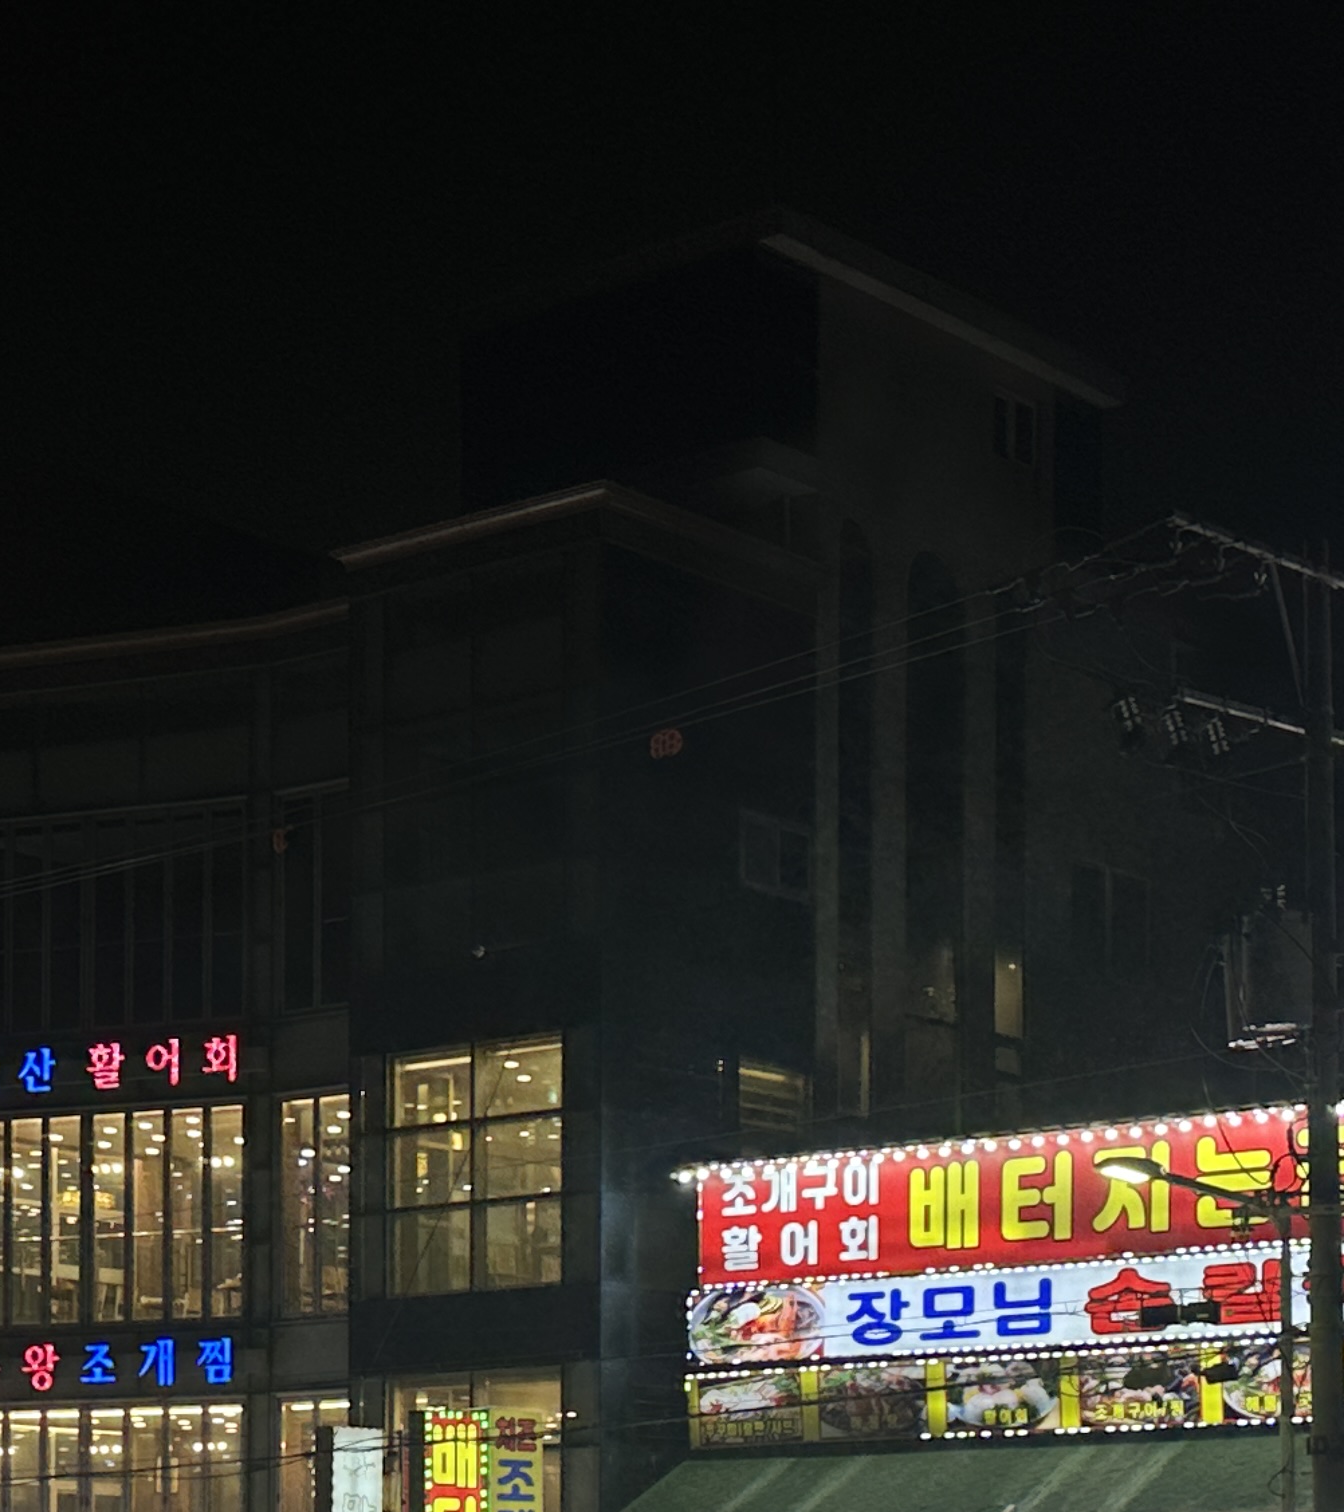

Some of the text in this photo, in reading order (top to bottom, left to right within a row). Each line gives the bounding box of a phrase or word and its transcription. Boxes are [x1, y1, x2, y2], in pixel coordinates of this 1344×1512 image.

[85, 1034, 239, 1091] 활어회
[721, 1161, 880, 1218] 조개구이
[721, 1216, 880, 1273] 활어회
[847, 1277, 1053, 1347] 장모님
